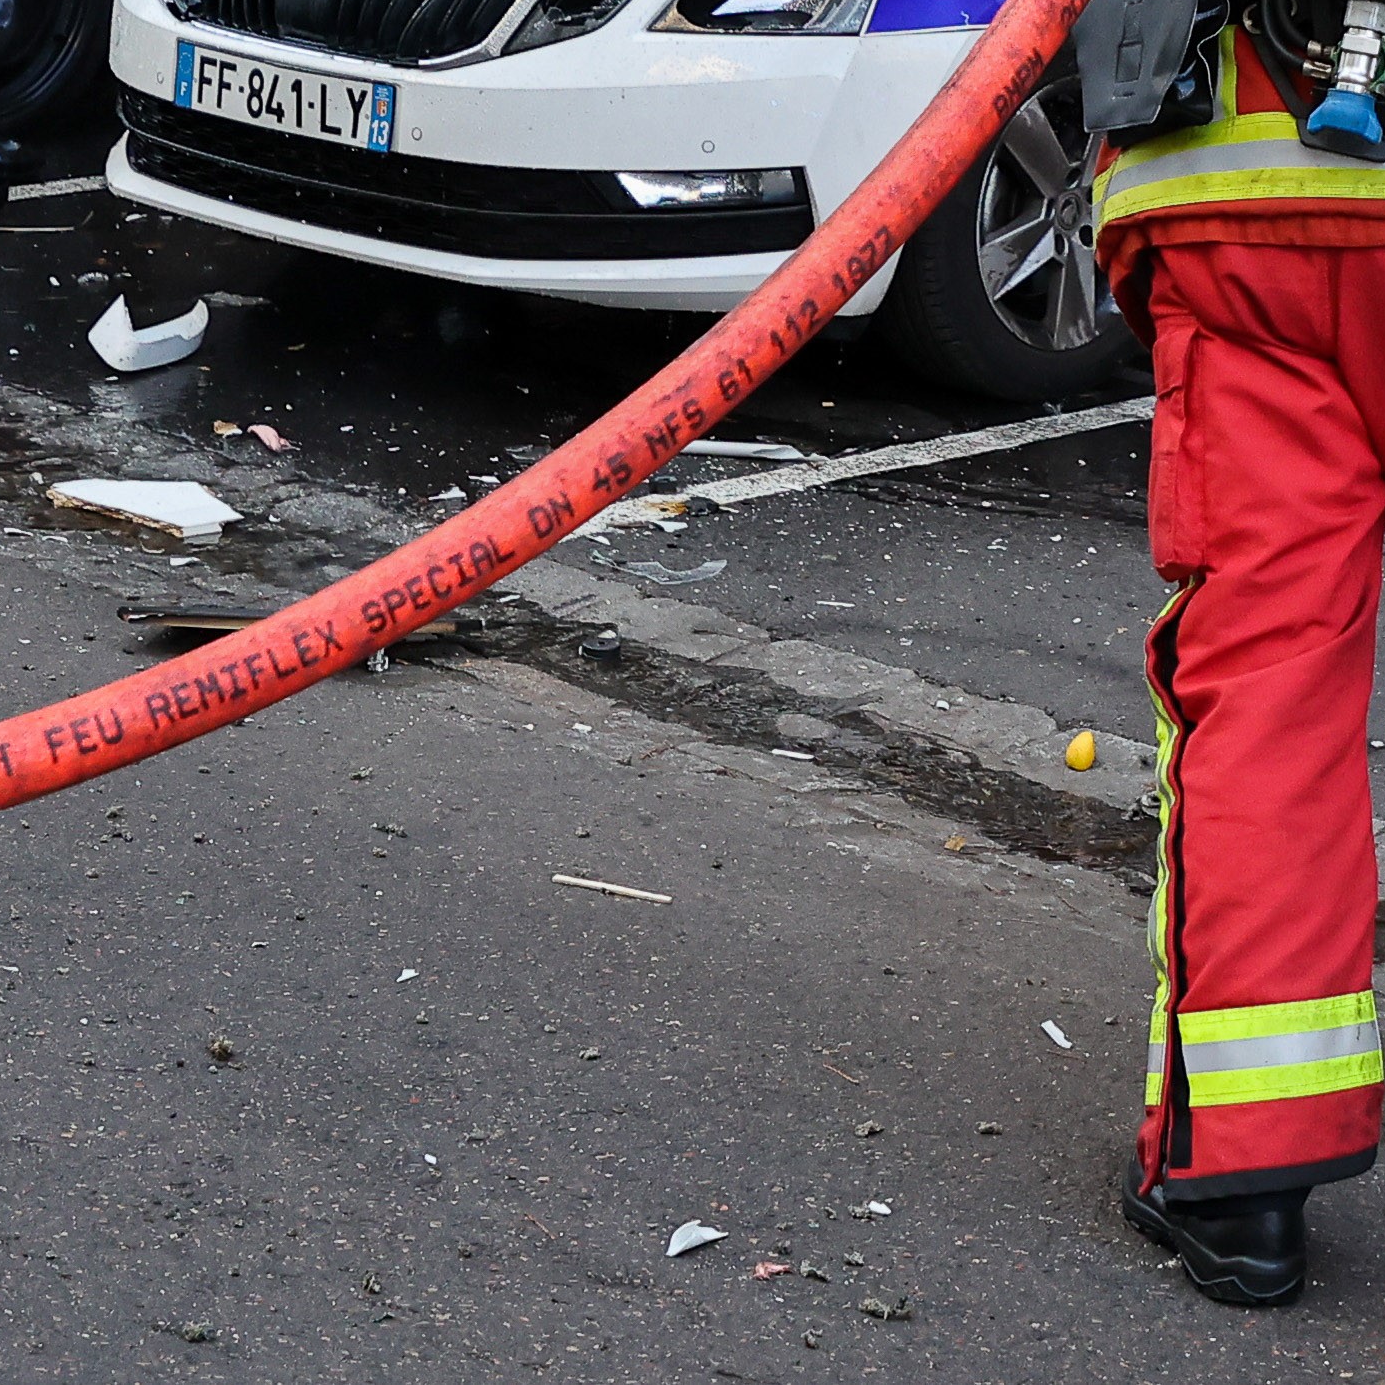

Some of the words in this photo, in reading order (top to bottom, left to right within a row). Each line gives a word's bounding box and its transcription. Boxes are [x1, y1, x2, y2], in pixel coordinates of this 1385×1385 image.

[196, 55, 369, 140] FF-841-LY
[370, 119, 390, 146] 13
[44, 708, 124, 765] FEU
[144, 620, 345, 731] REMIFLEX
[360, 534, 516, 634] SPECIAL
[527, 490, 576, 540] DN
[592, 451, 633, 494] 45
[643, 398, 707, 461] NFS
[717, 358, 753, 402] 61
[769, 298, 820, 356] 112
